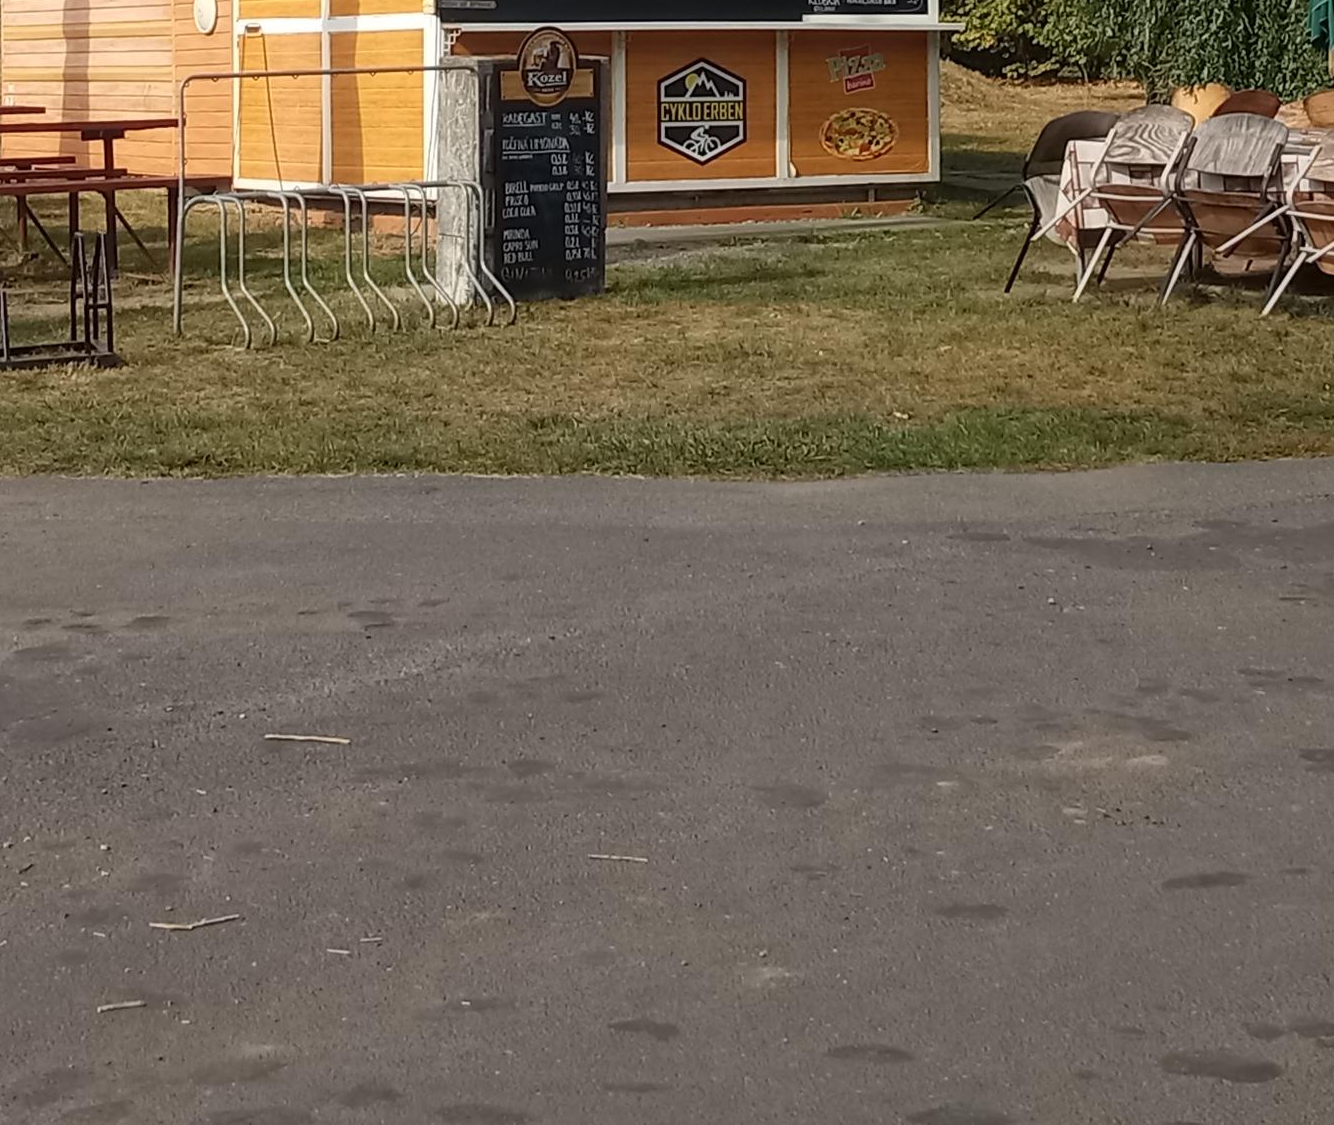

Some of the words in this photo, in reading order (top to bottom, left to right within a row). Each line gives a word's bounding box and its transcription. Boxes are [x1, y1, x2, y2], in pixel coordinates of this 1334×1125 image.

[527, 71, 567, 87] Kozel
[661, 102, 702, 122] CYKLO
[703, 101, 744, 121] ERBEN
